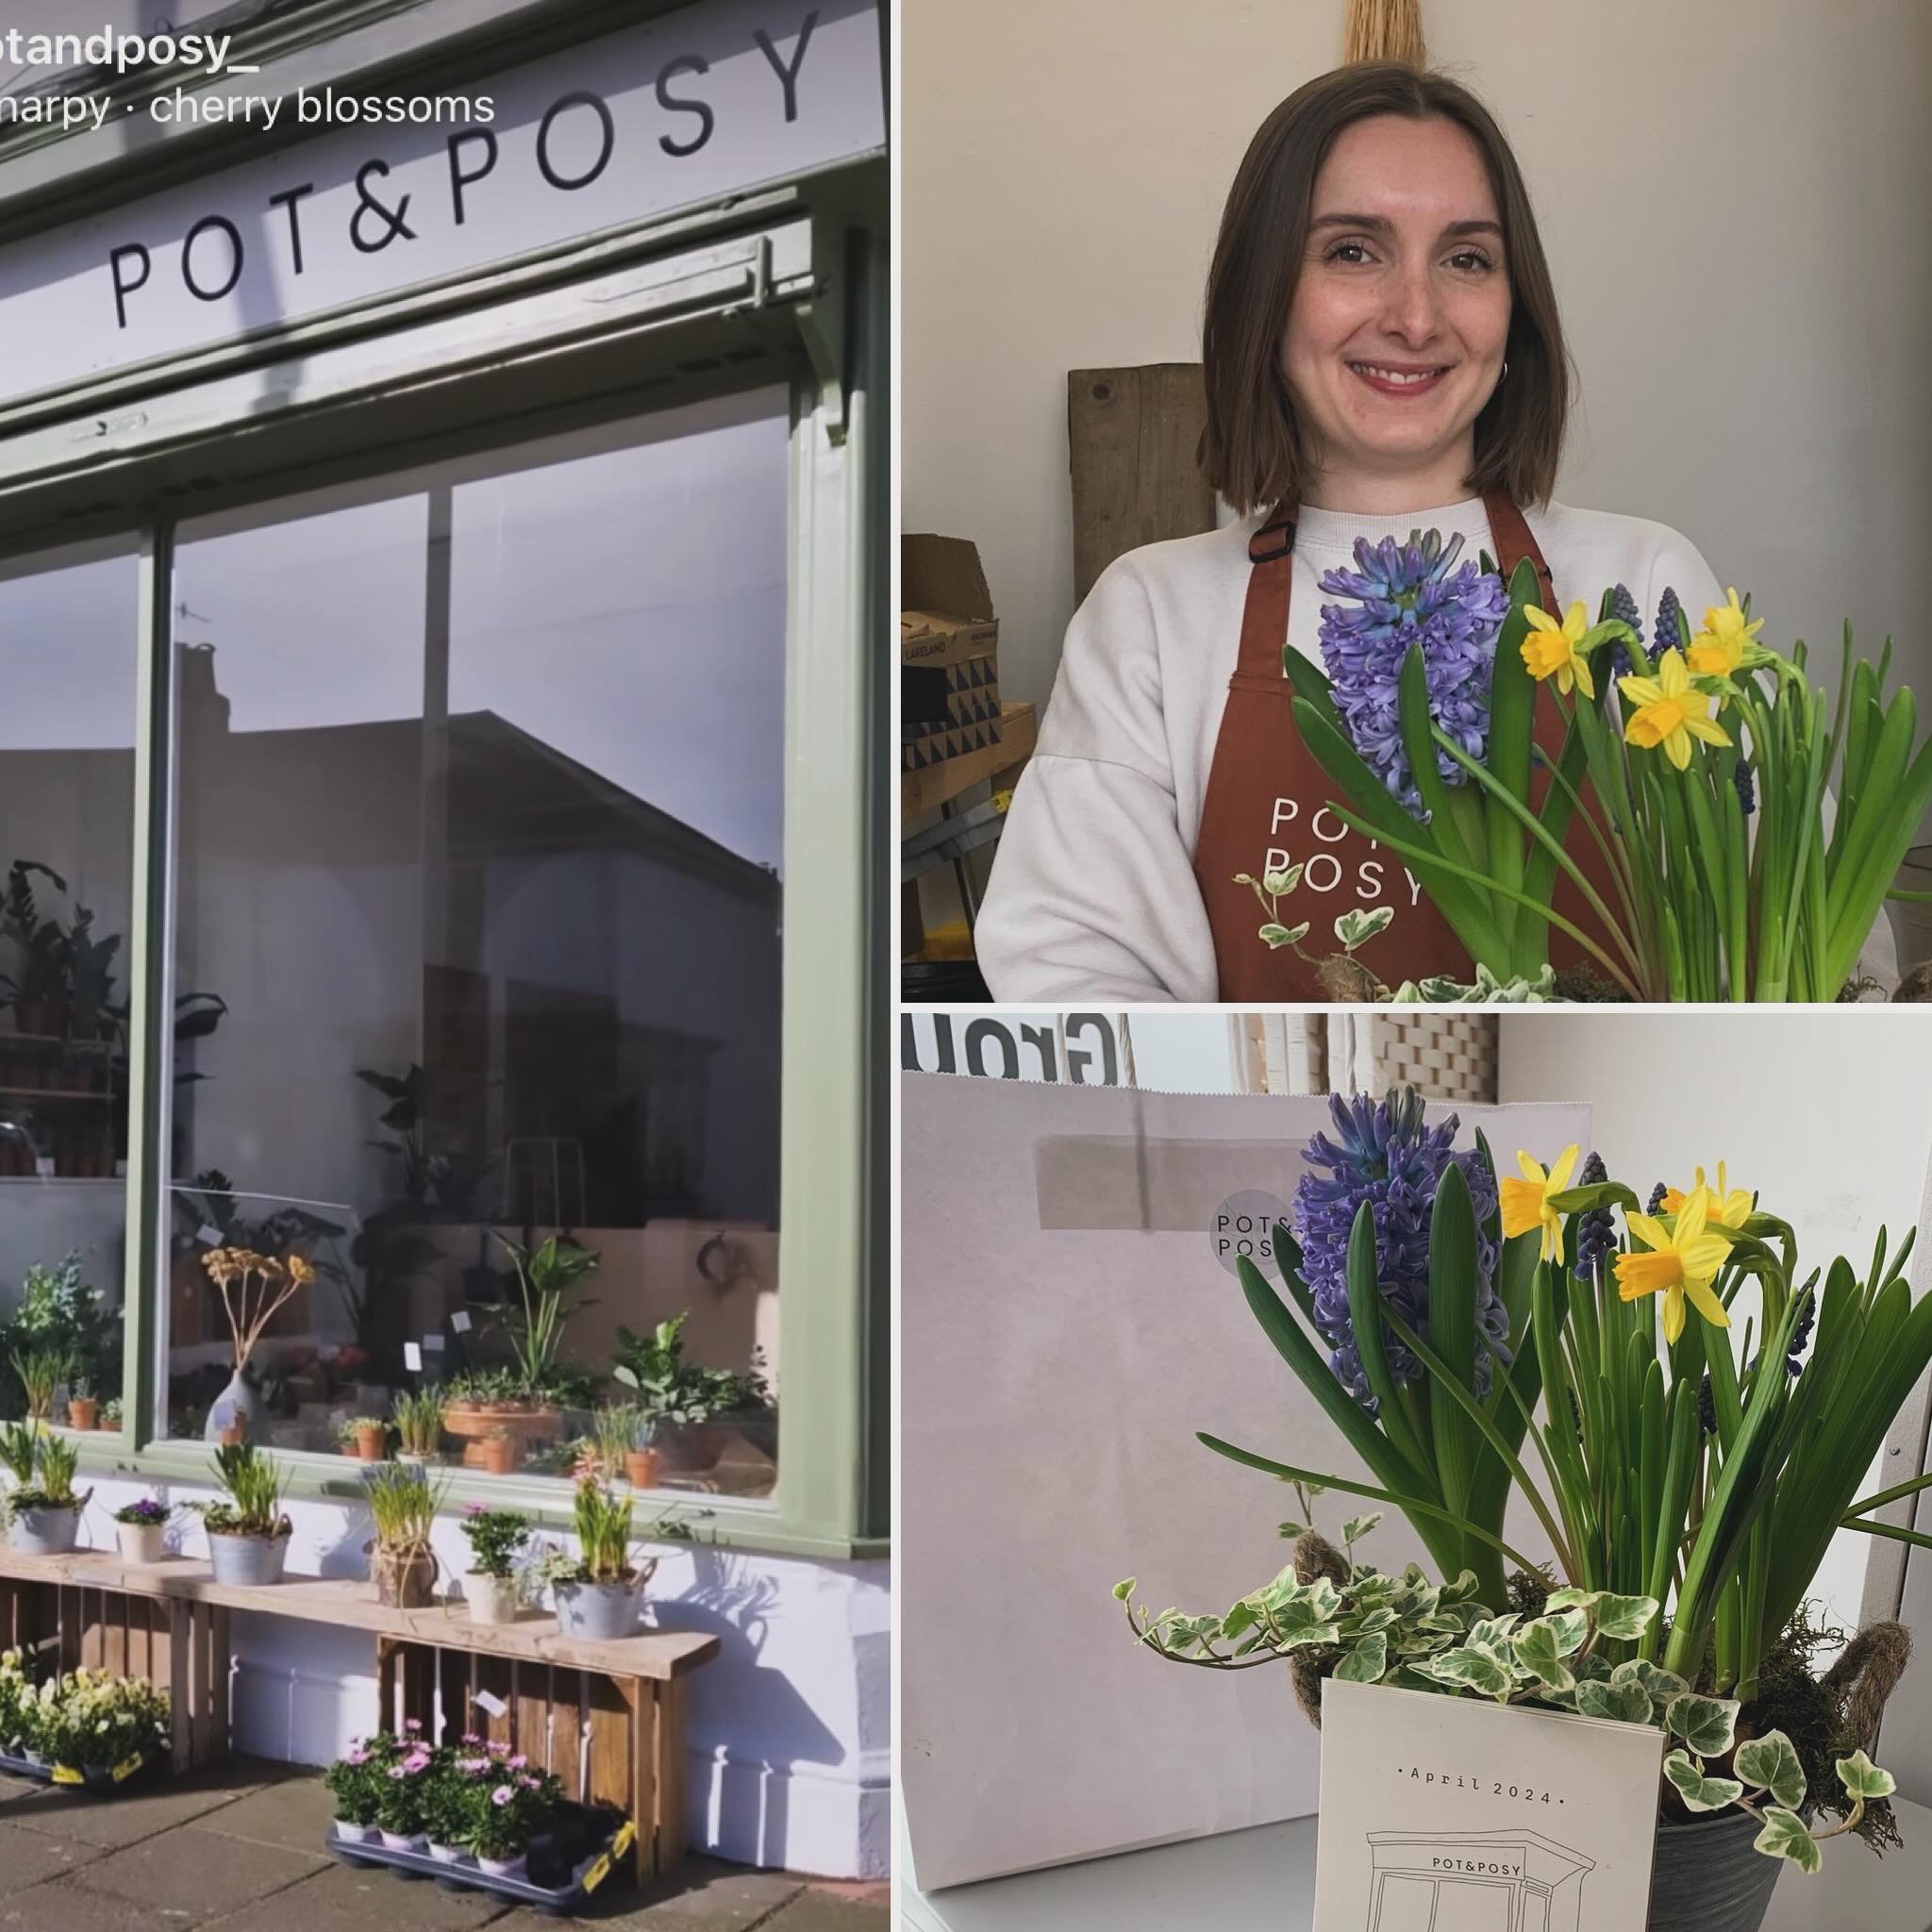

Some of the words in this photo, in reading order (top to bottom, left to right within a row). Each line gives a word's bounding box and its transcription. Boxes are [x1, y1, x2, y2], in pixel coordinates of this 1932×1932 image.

[110, 10, 820, 328] POT&POSY
[1271, 797, 1377, 850] PO
[1263, 848, 1422, 907] POSY
[1432, 1857, 1522, 1876] POT&POSY
